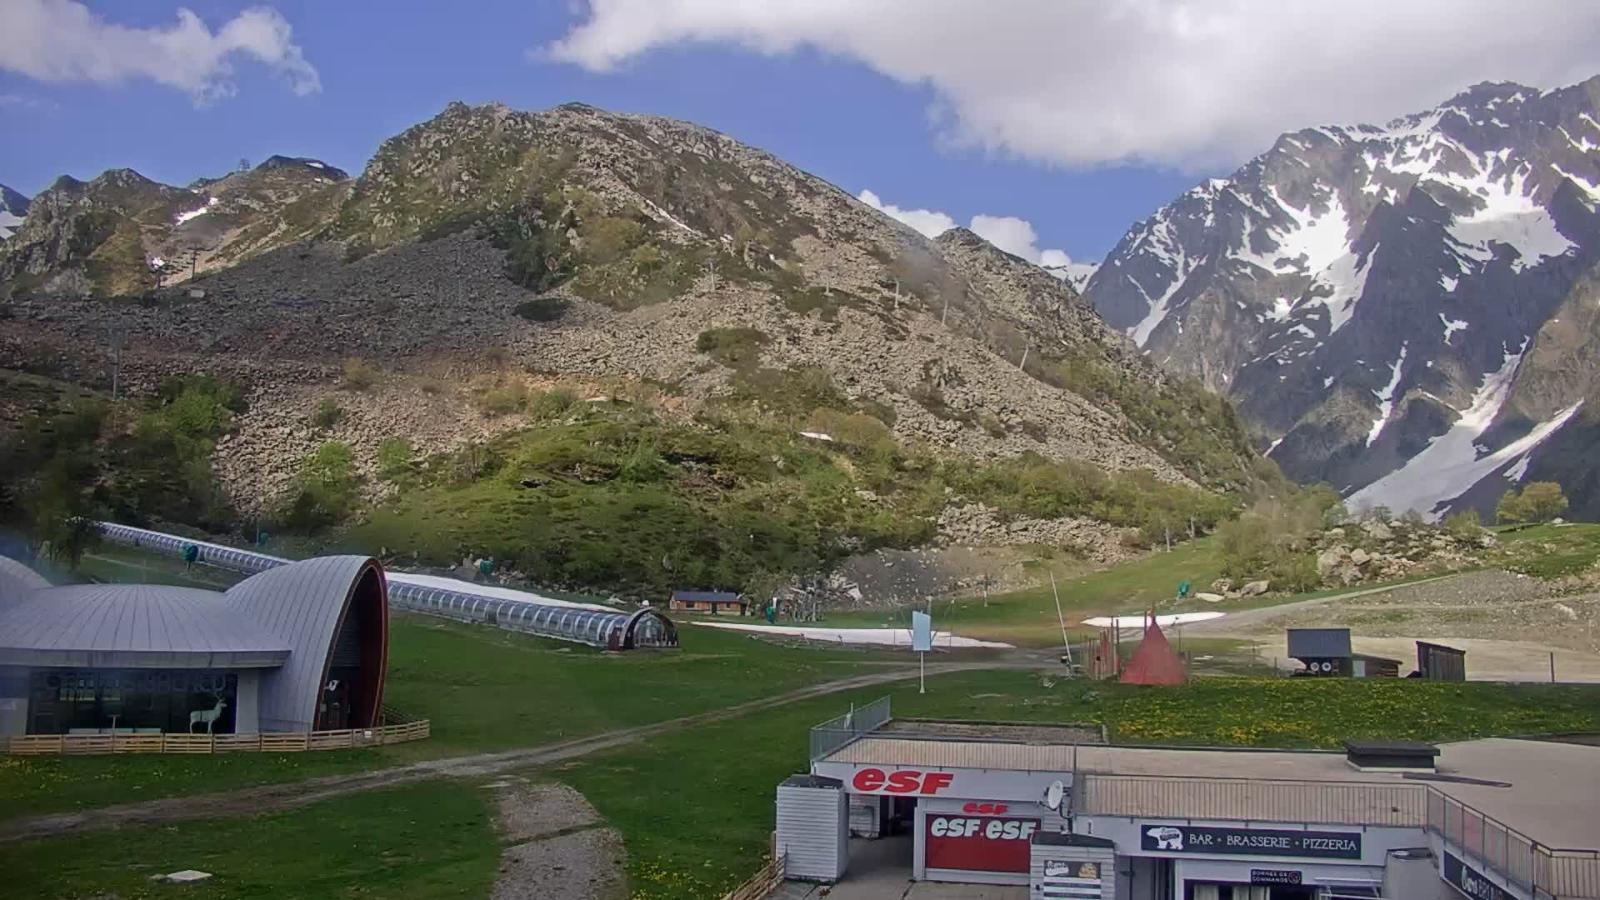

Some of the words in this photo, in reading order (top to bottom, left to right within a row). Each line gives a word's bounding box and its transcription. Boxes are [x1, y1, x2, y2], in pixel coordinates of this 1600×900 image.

[1189, 833, 1214, 845] BAR
[1226, 835, 1291, 849] BRASSERIE
[1302, 837, 1357, 851] PIZZERIA
